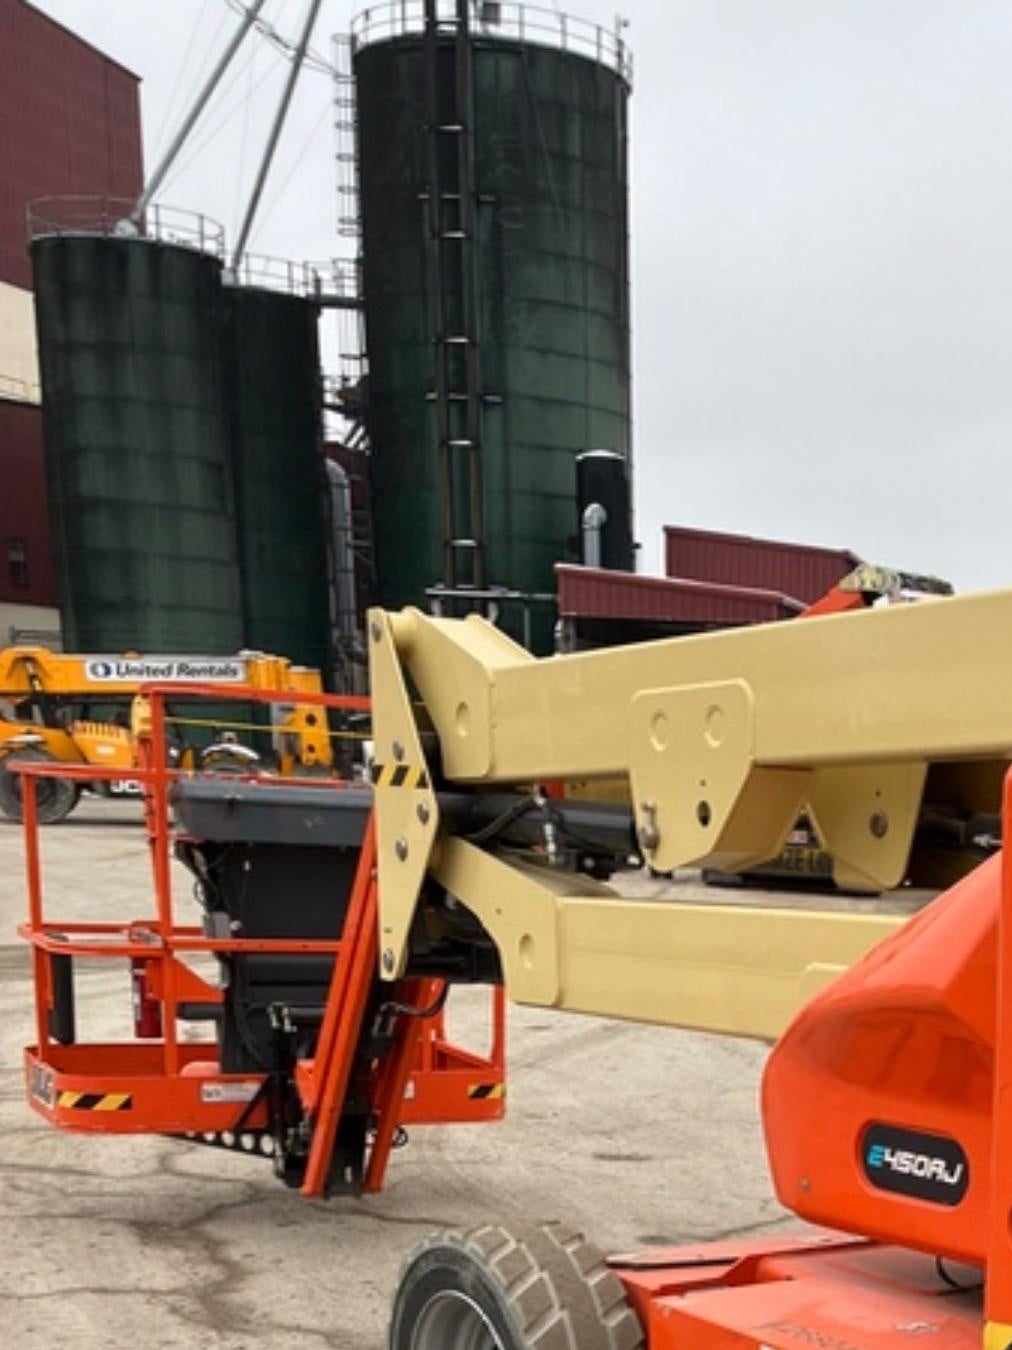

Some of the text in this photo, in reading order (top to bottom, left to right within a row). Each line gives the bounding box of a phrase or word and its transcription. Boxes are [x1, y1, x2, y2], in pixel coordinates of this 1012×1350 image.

[116, 663, 238, 677] United Rentals
[110, 778, 146, 793] JC
